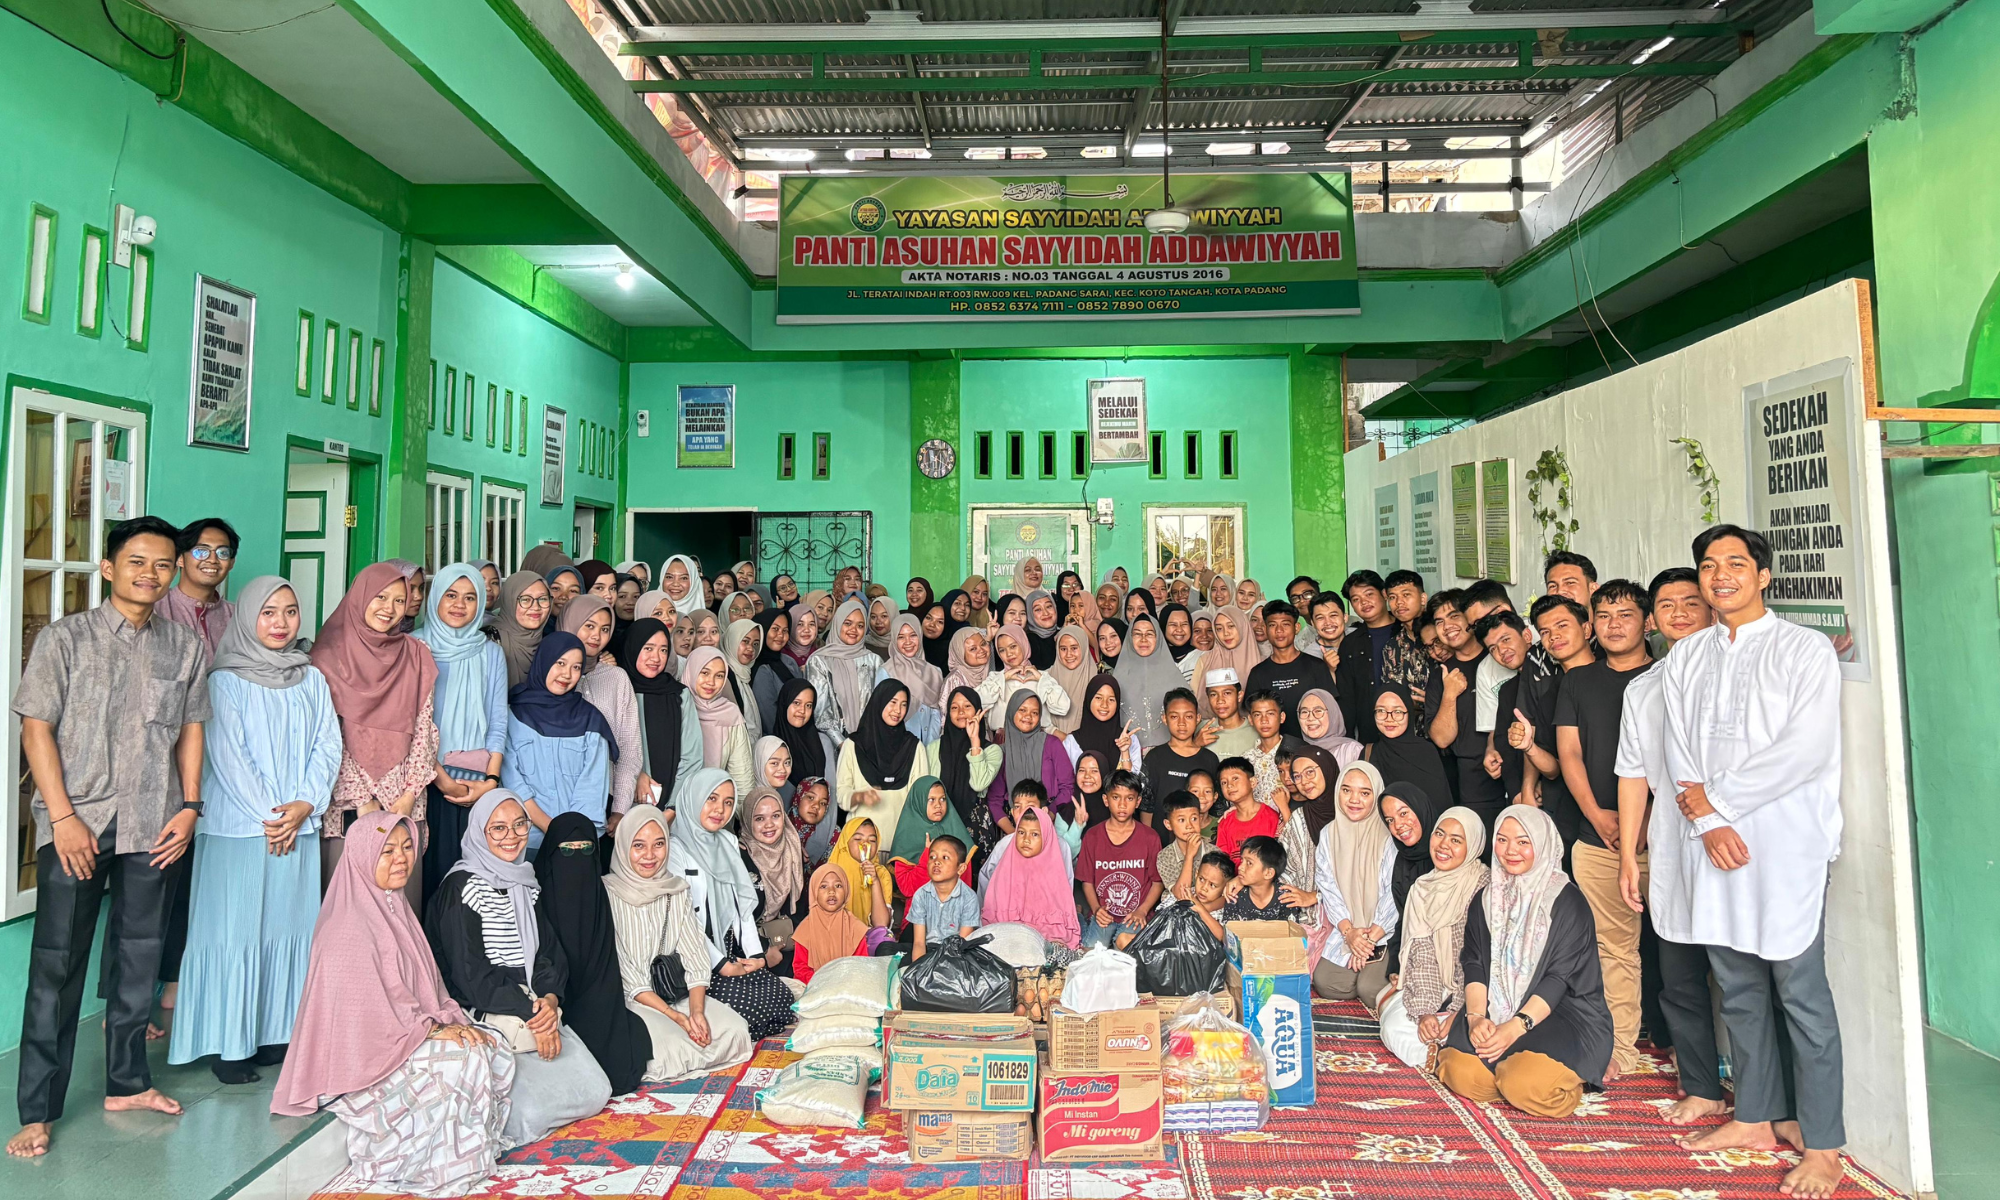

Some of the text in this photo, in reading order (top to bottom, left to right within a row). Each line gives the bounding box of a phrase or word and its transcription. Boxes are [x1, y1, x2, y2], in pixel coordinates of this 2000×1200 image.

[894, 207, 1281, 229] YAYASAN SAYYIDAH AWIYYAH
[794, 232, 1341, 266] PANTI ASUHAN SAYYIDAH ADDAWIYYAH
[908, 272, 942, 281] AKTA
[946, 272, 1001, 281] NOTARIS
[1012, 272, 1049, 281] NO.03
[1053, 271, 1113, 281] TANGGAL
[1116, 271, 1125, 281] 4
[1128, 270, 1189, 280] AGUSTUS
[1193, 269, 1223, 279] 2016
[847, 290, 861, 299] JL.
[863, 290, 903, 299] TERATAI
[905, 290, 936, 299] INDAH
[939, 290, 972, 298] RT.003
[974, 290, 1011, 298] RW.009
[1013, 290, 1034, 298] KEL.
[1036, 290, 1077, 298] PADANG
[1079, 290, 1112, 298] SARAI,
[1139, 289, 1167, 297] KOTO
[1169, 288, 1213, 297] TANGAH,
[1215, 287, 1242, 296] KOTA
[1244, 286, 1287, 295] PADANG
[950, 302, 971, 311] HP.
[974, 302, 1006, 311] 0852
[1009, 302, 1039, 311] 6374
[1042, 302, 1064, 311] 7111
[1077, 301, 1109, 311] 0852
[1111, 301, 1145, 310] 7890
[1147, 300, 1180, 309] 0670
[204, 321, 226, 336] SEHEBAT
[203, 334, 243, 355] APAPUN KAMU
[202, 358, 242, 380] TIDAK SHALAT
[201, 384, 229, 402] BERARTI
[1098, 397, 1138, 408] MELALUI
[685, 408, 725, 417] BUKAN APA
[1098, 408, 1138, 418] SEDEKAH
[1762, 391, 1828, 437] SEDEKAH
[685, 424, 725, 432] MELAINKAN
[1098, 431, 1139, 440] BERTAMBAH
[1768, 430, 1825, 461] YANG ANDA
[1768, 456, 1829, 495] BERIKAN
[1770, 503, 1831, 527] AKAN MENJADI
[1812, 525, 1844, 549] ANDA
[1779, 552, 1826, 573] PADA HARI
[1095, 859, 1145, 869] POCHINKI
[1271, 1008, 1296, 1077] AQUA
[916, 1068, 958, 1091] Daia
[988, 1062, 1029, 1079] 1061829
[1063, 1124, 1141, 1141] Mi goreng
